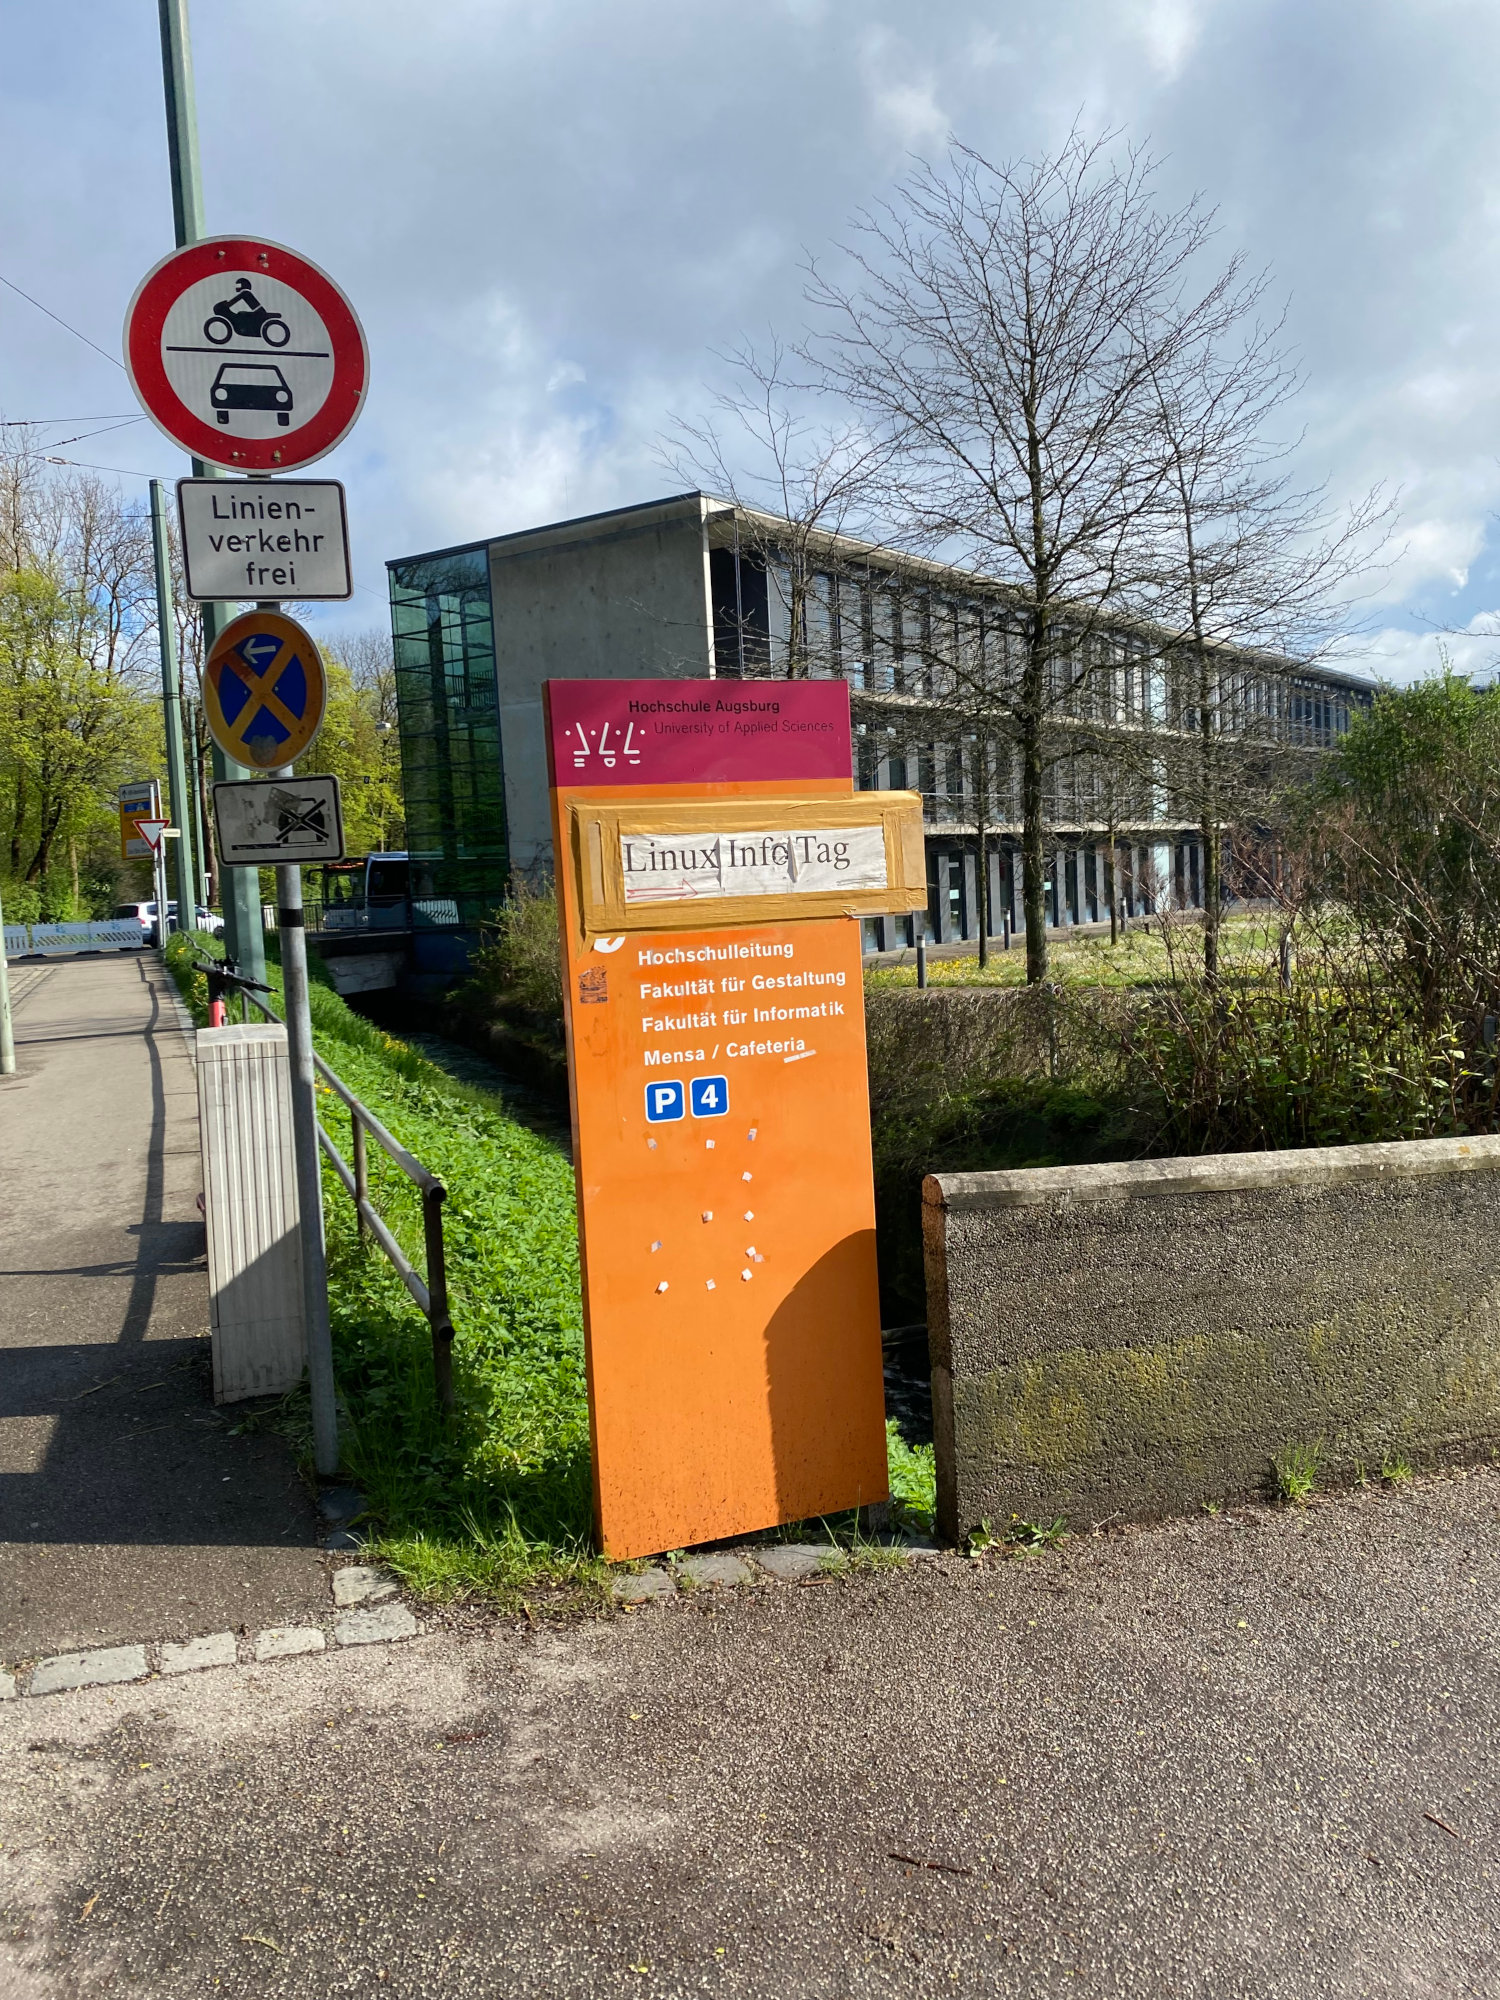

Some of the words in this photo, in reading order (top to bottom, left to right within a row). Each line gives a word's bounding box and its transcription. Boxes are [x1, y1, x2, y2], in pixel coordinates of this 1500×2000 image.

[211, 495, 315, 519] Linien-
[208, 528, 325, 553] verkehr
[246, 561, 296, 585] frei
[628, 700, 711, 713] Hochschule
[715, 700, 780, 714] Augsburg
[654, 721, 714, 737] University
[718, 721, 730, 733] of
[734, 720, 778, 736] Applied
[782, 720, 834, 732] Sciences
[623, 842, 720, 872] Linux
[796, 835, 850, 870] Tag
[638, 943, 794, 966] Hochschulleitung
[640, 978, 715, 999] Fakultät
[721, 977, 746, 992] für
[752, 971, 846, 990] Gestaltung
[642, 1012, 717, 1033] Fakultät
[723, 1010, 748, 1025] für
[753, 1001, 845, 1023] Informatik
[644, 1049, 705, 1066] Mensa
[712, 1044, 719, 1060] /
[726, 1037, 806, 1058] Cafeteria
[655, 1087, 677, 1114] P
[700, 1084, 719, 1109] 4
